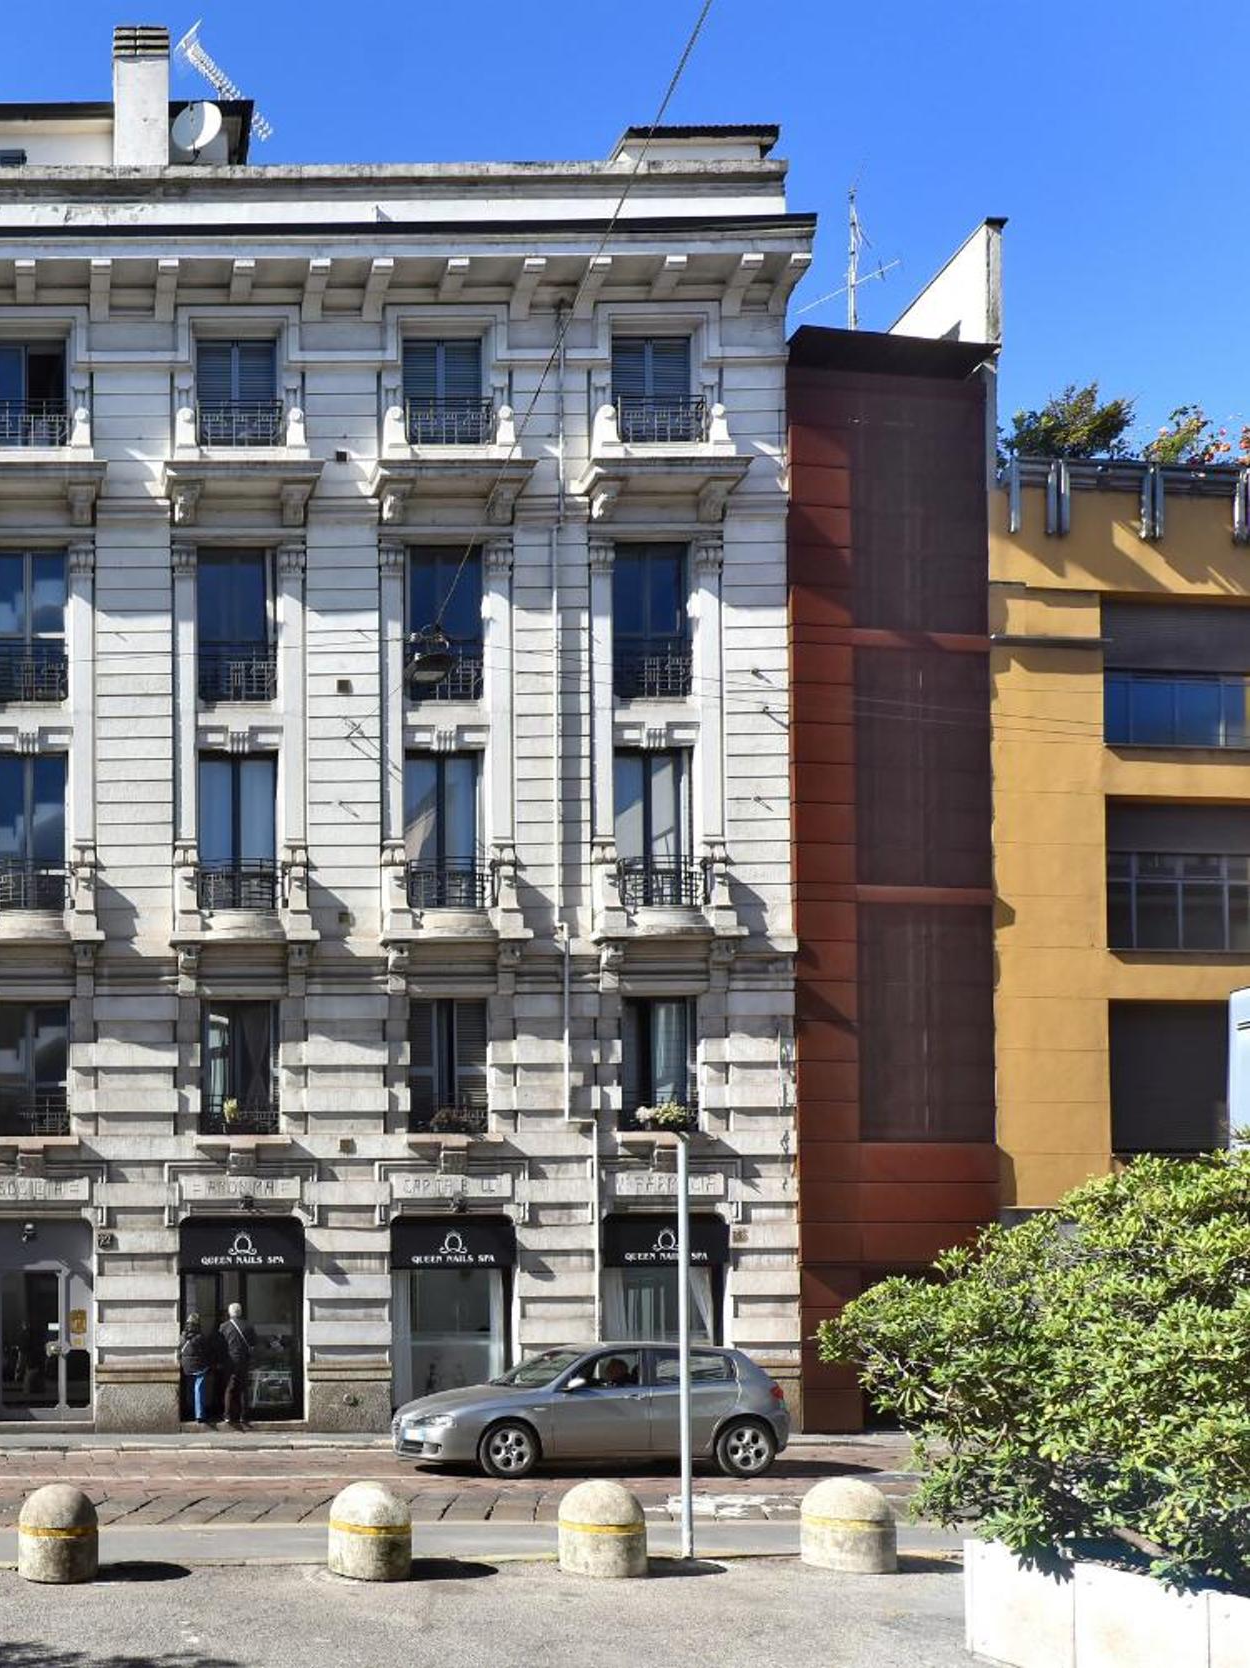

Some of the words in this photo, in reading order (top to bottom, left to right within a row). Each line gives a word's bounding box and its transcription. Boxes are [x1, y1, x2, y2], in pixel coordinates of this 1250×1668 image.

[201, 1256, 233, 1265] QUEEN
[236, 1256, 263, 1264] NAILS
[267, 1256, 285, 1264] SPA
[411, 1255, 443, 1264] QUEEN
[446, 1255, 474, 1263] NAILS
[477, 1254, 496, 1263] SPA
[624, 1252, 656, 1262] QUEEN
[691, 1252, 709, 1261] SPA
